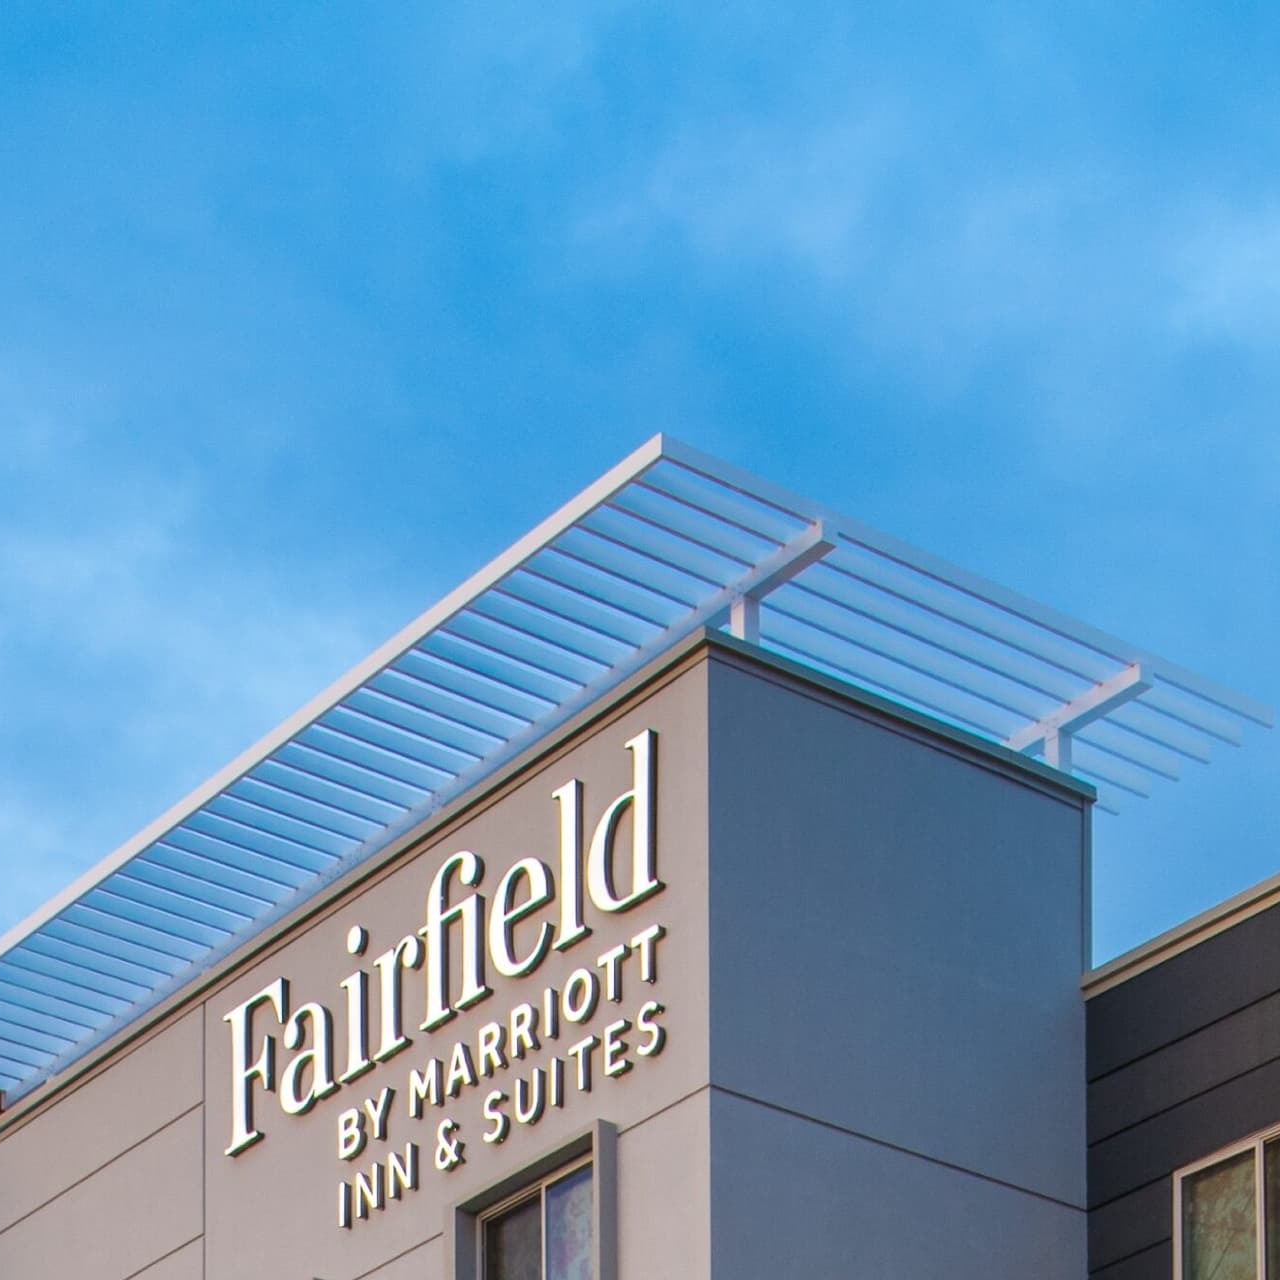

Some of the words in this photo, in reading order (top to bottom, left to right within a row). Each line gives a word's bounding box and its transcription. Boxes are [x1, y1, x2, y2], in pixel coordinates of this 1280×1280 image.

[223, 728, 666, 1157] Fairfield
[338, 1087, 396, 1160] BY
[409, 924, 666, 1118] MARRIOTT
[337, 1143, 418, 1229] INN
[434, 1118, 465, 1170] &
[483, 1001, 666, 1144] SUITES
